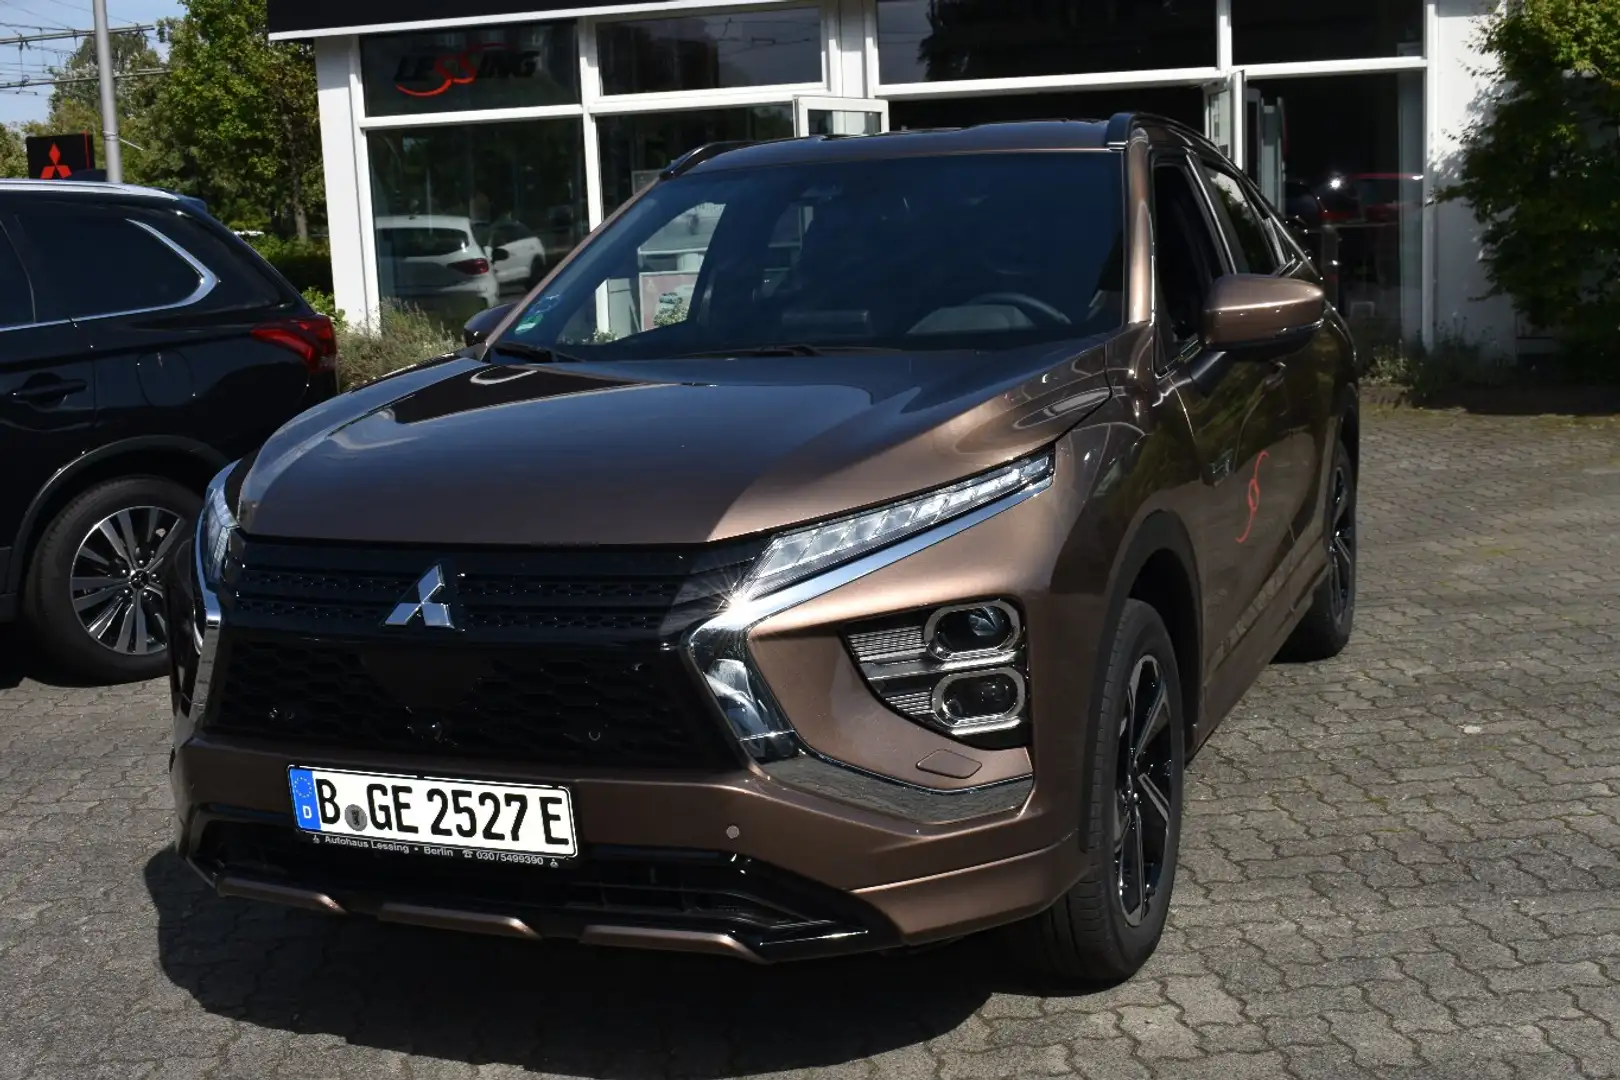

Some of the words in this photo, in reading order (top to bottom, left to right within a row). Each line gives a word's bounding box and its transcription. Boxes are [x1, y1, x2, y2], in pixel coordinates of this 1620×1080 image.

[393, 44, 540, 97] LESSING
[302, 805, 313, 819] D
[316, 778, 341, 825] B
[366, 783, 419, 834] GE
[426, 788, 528, 842] 2527
[539, 796, 570, 846] E
[324, 835, 369, 849] Autohaus
[371, 839, 410, 854] Lessing
[423, 846, 454, 858] Berlin
